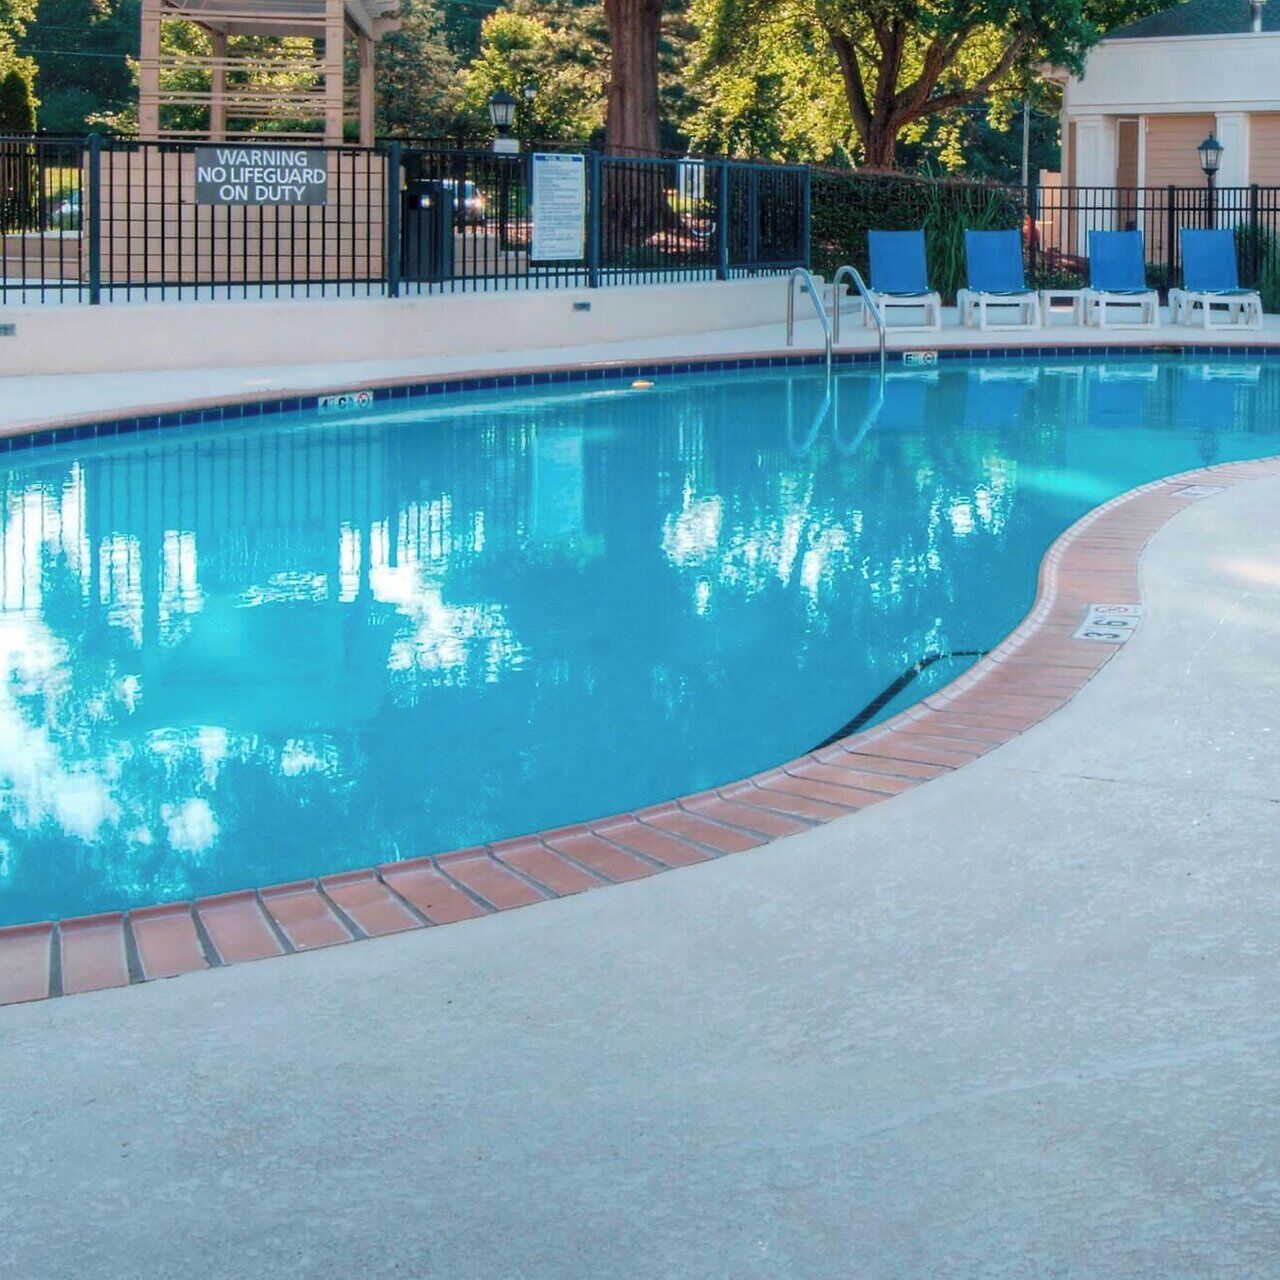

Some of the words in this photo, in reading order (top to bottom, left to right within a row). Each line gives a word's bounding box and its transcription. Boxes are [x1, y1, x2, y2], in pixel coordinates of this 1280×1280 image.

[216, 149, 308, 167] WARNING
[198, 168, 225, 183] NO
[231, 168, 326, 184] LIFEGUARD
[220, 185, 248, 201] ON
[255, 185, 306, 202] DUTY
